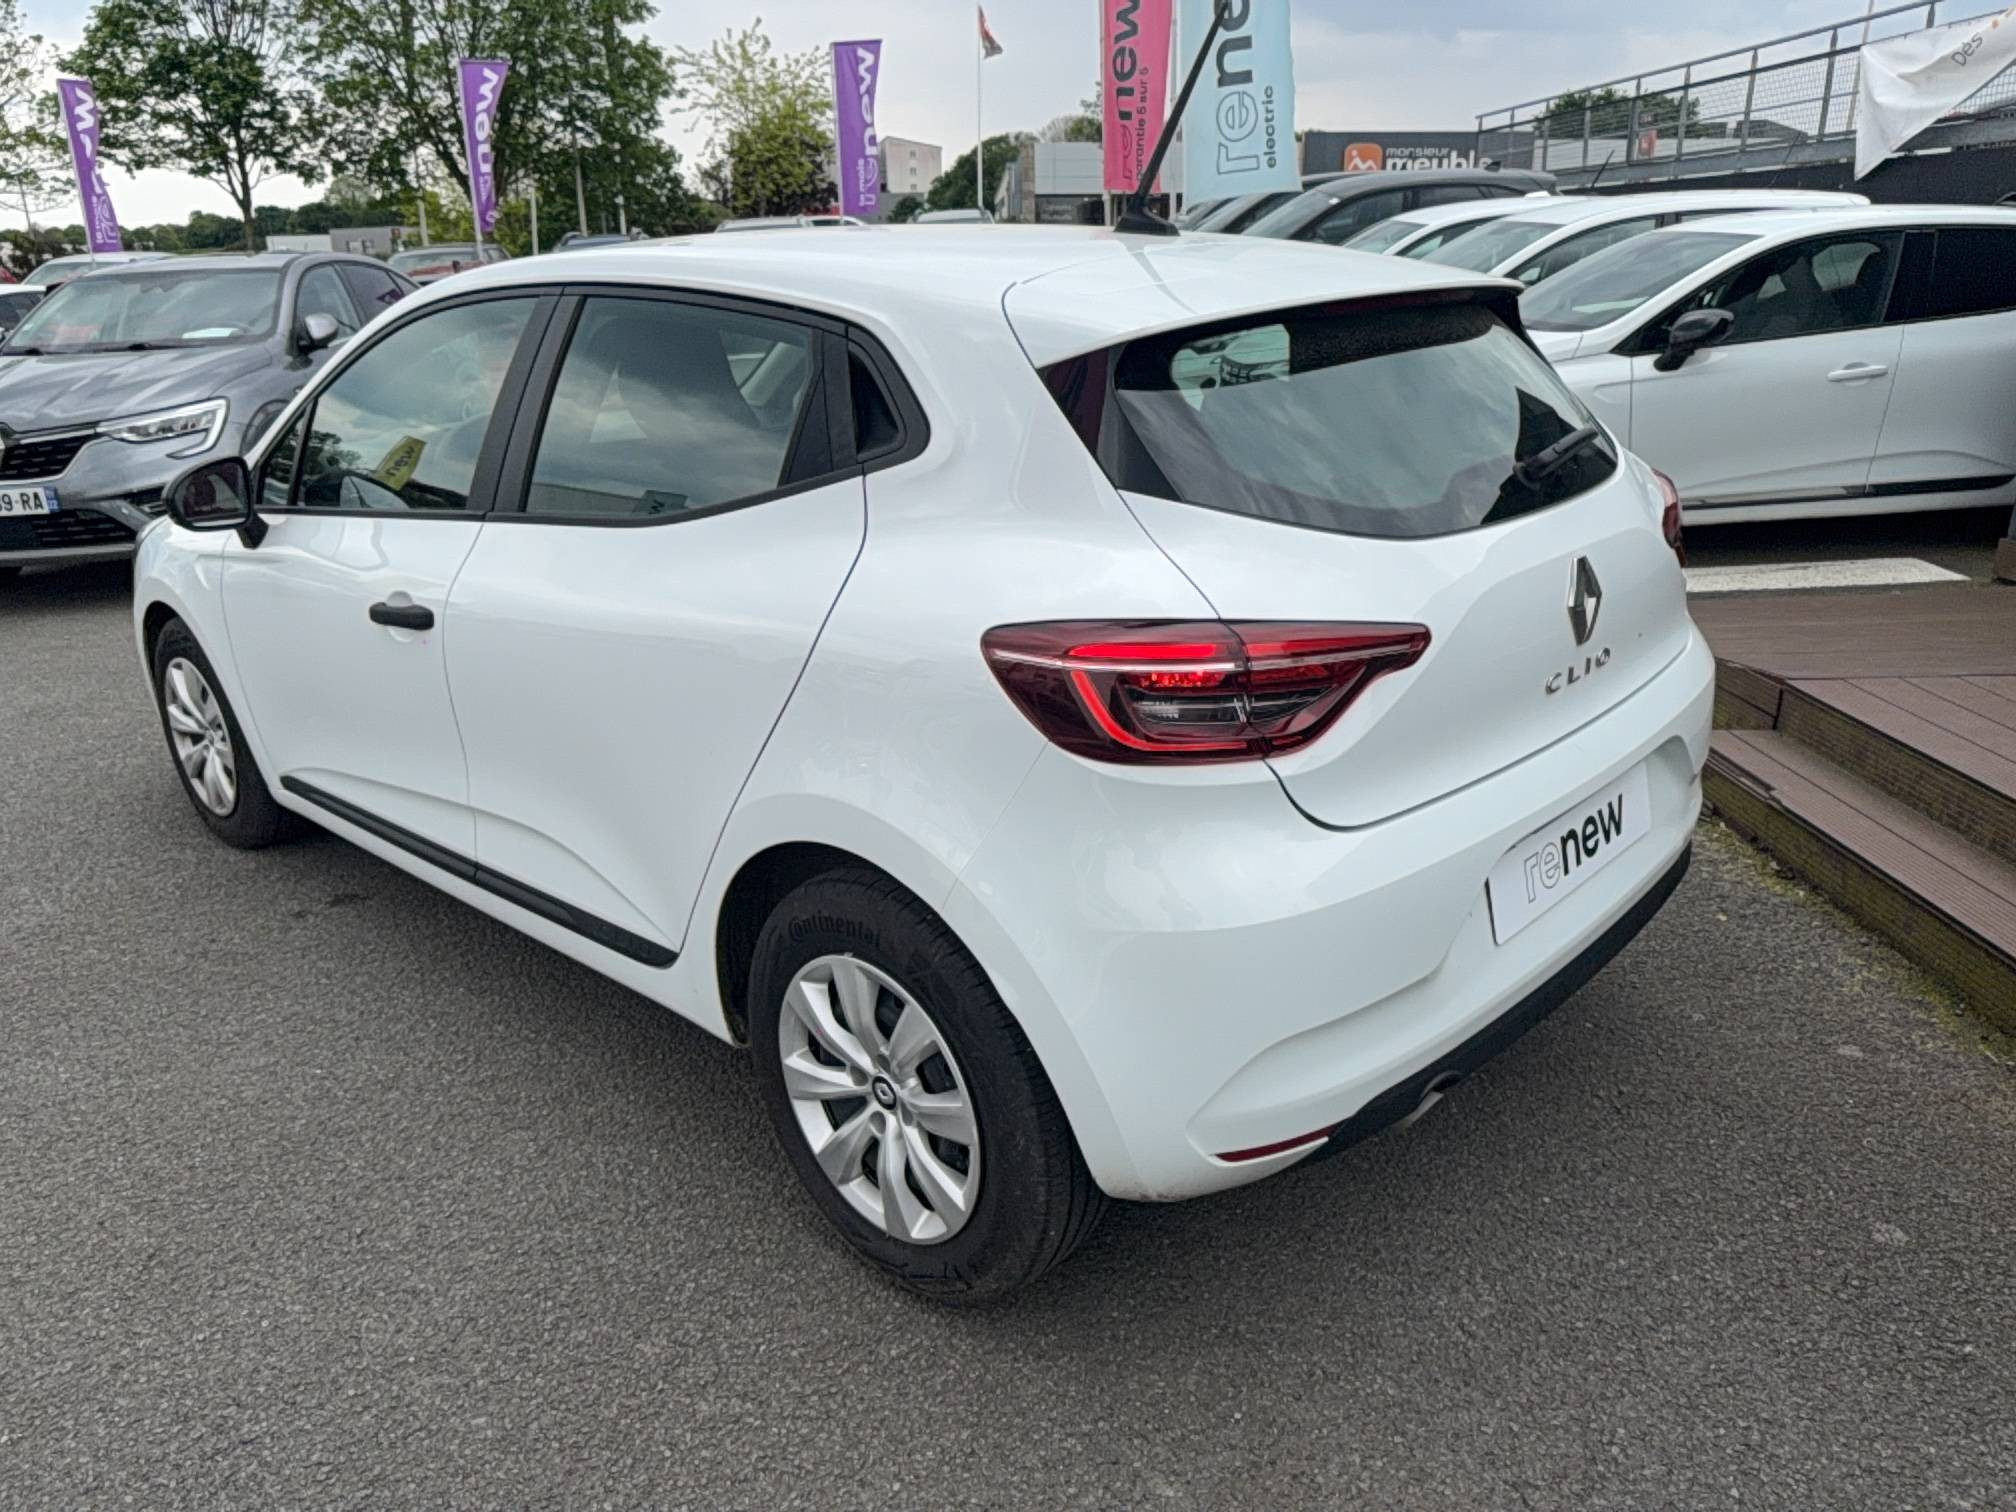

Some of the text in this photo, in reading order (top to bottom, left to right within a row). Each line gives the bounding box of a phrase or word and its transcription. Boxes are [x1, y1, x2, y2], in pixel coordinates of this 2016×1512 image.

[1261, 85, 1277, 169] electric
[1385, 146, 1450, 158] monsieur
[0, 491, 44, 512] 9-RA
[1546, 647, 1611, 695] CLIO
[1523, 793, 1623, 904] renew
[788, 910, 880, 948] Continental
